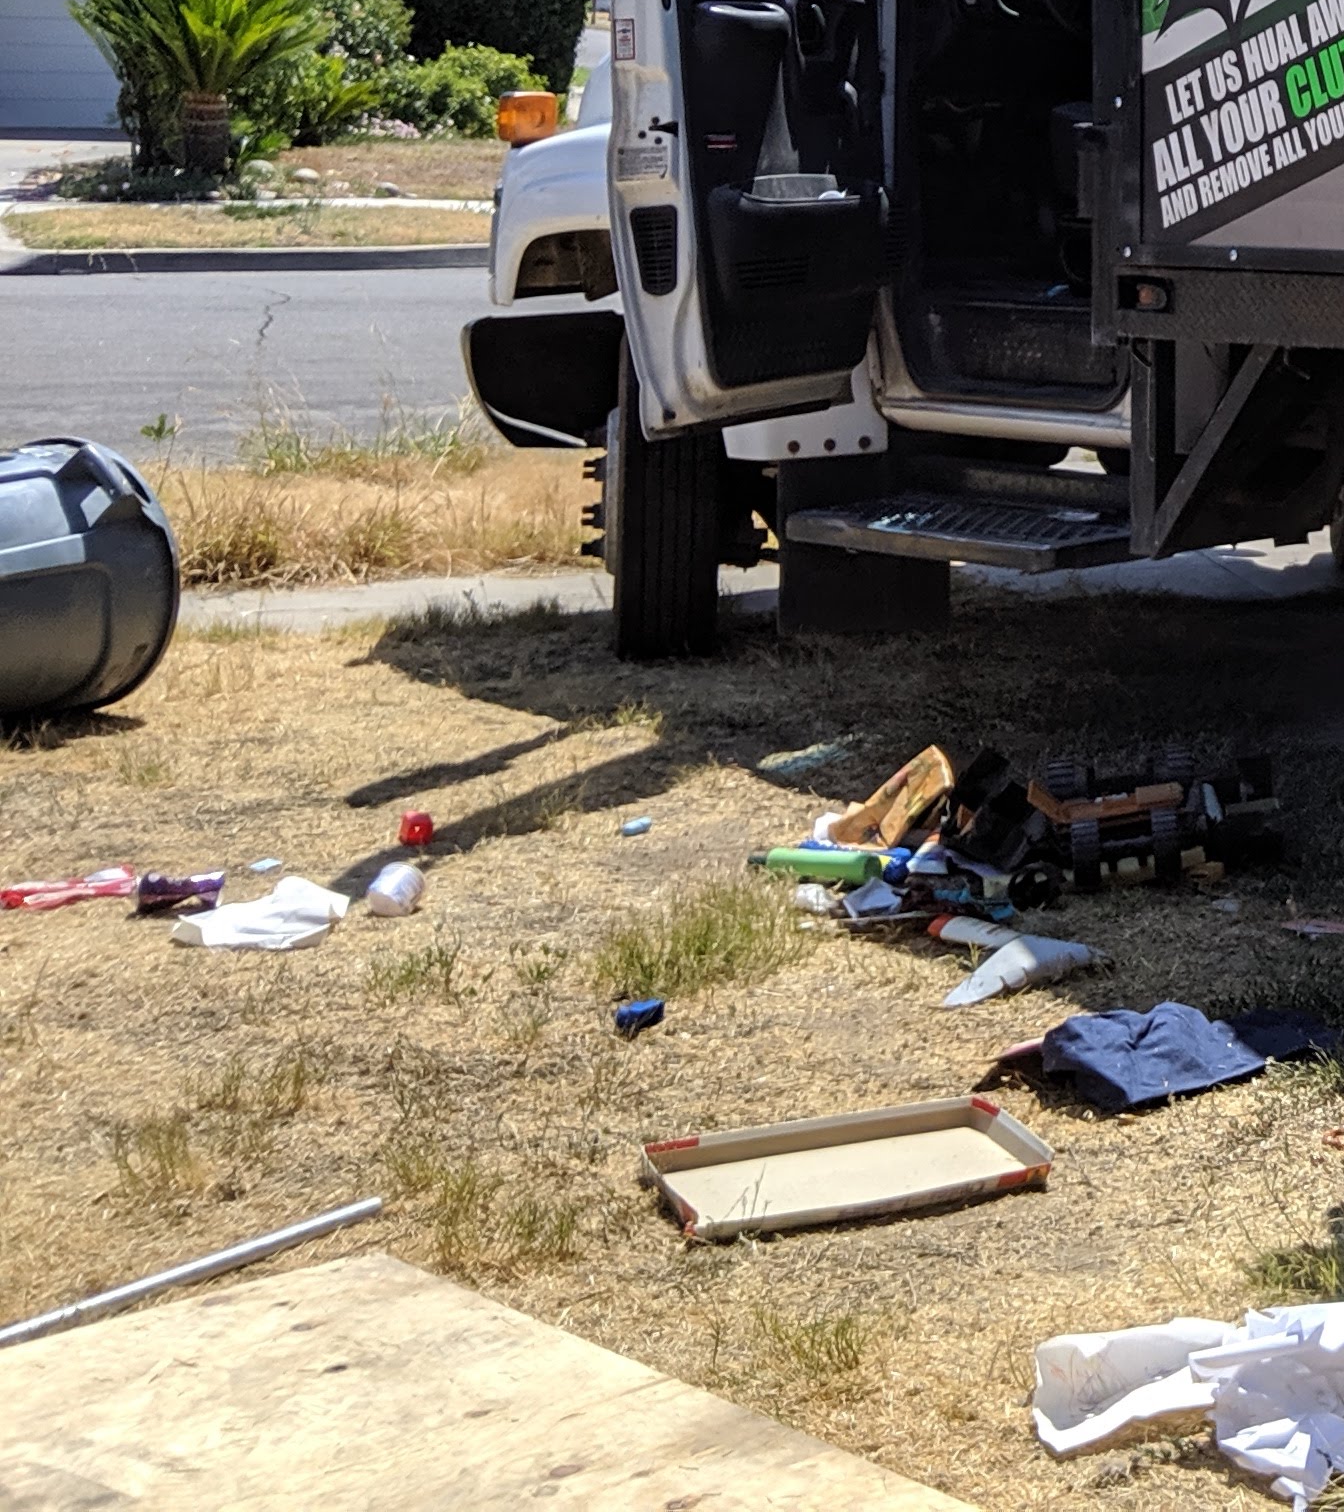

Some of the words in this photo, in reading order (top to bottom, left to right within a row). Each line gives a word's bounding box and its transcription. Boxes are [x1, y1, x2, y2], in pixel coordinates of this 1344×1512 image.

[1165, 68, 1205, 125] LET
[1205, 49, 1243, 101] US
[1241, 13, 1308, 83] HUAL
[1152, 124, 1204, 192] ALL
[1200, 79, 1286, 163] YOUR
[1160, 178, 1199, 228] AND
[1198, 142, 1273, 209] REMOVE
[1272, 127, 1307, 170] ALL
